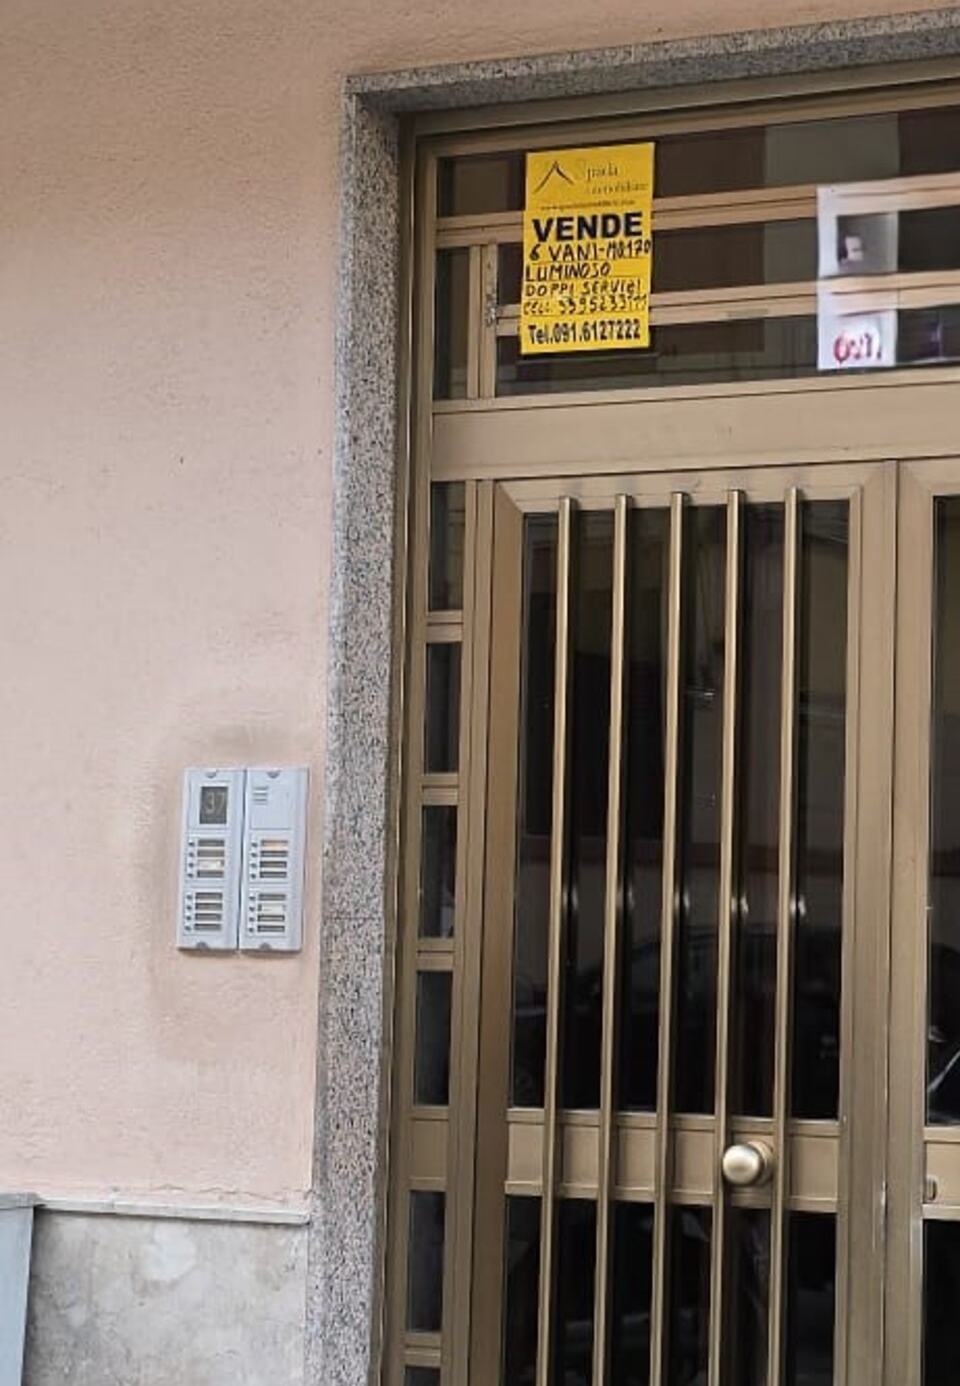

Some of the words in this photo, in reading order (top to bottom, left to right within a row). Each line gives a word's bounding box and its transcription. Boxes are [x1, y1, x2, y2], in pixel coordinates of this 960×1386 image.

[532, 212, 643, 243] VENDE
[529, 244, 542, 261] 6
[525, 262, 611, 282] LUMINOSO
[525, 284, 575, 297] DOPPI
[204, 791, 226, 815] 37
